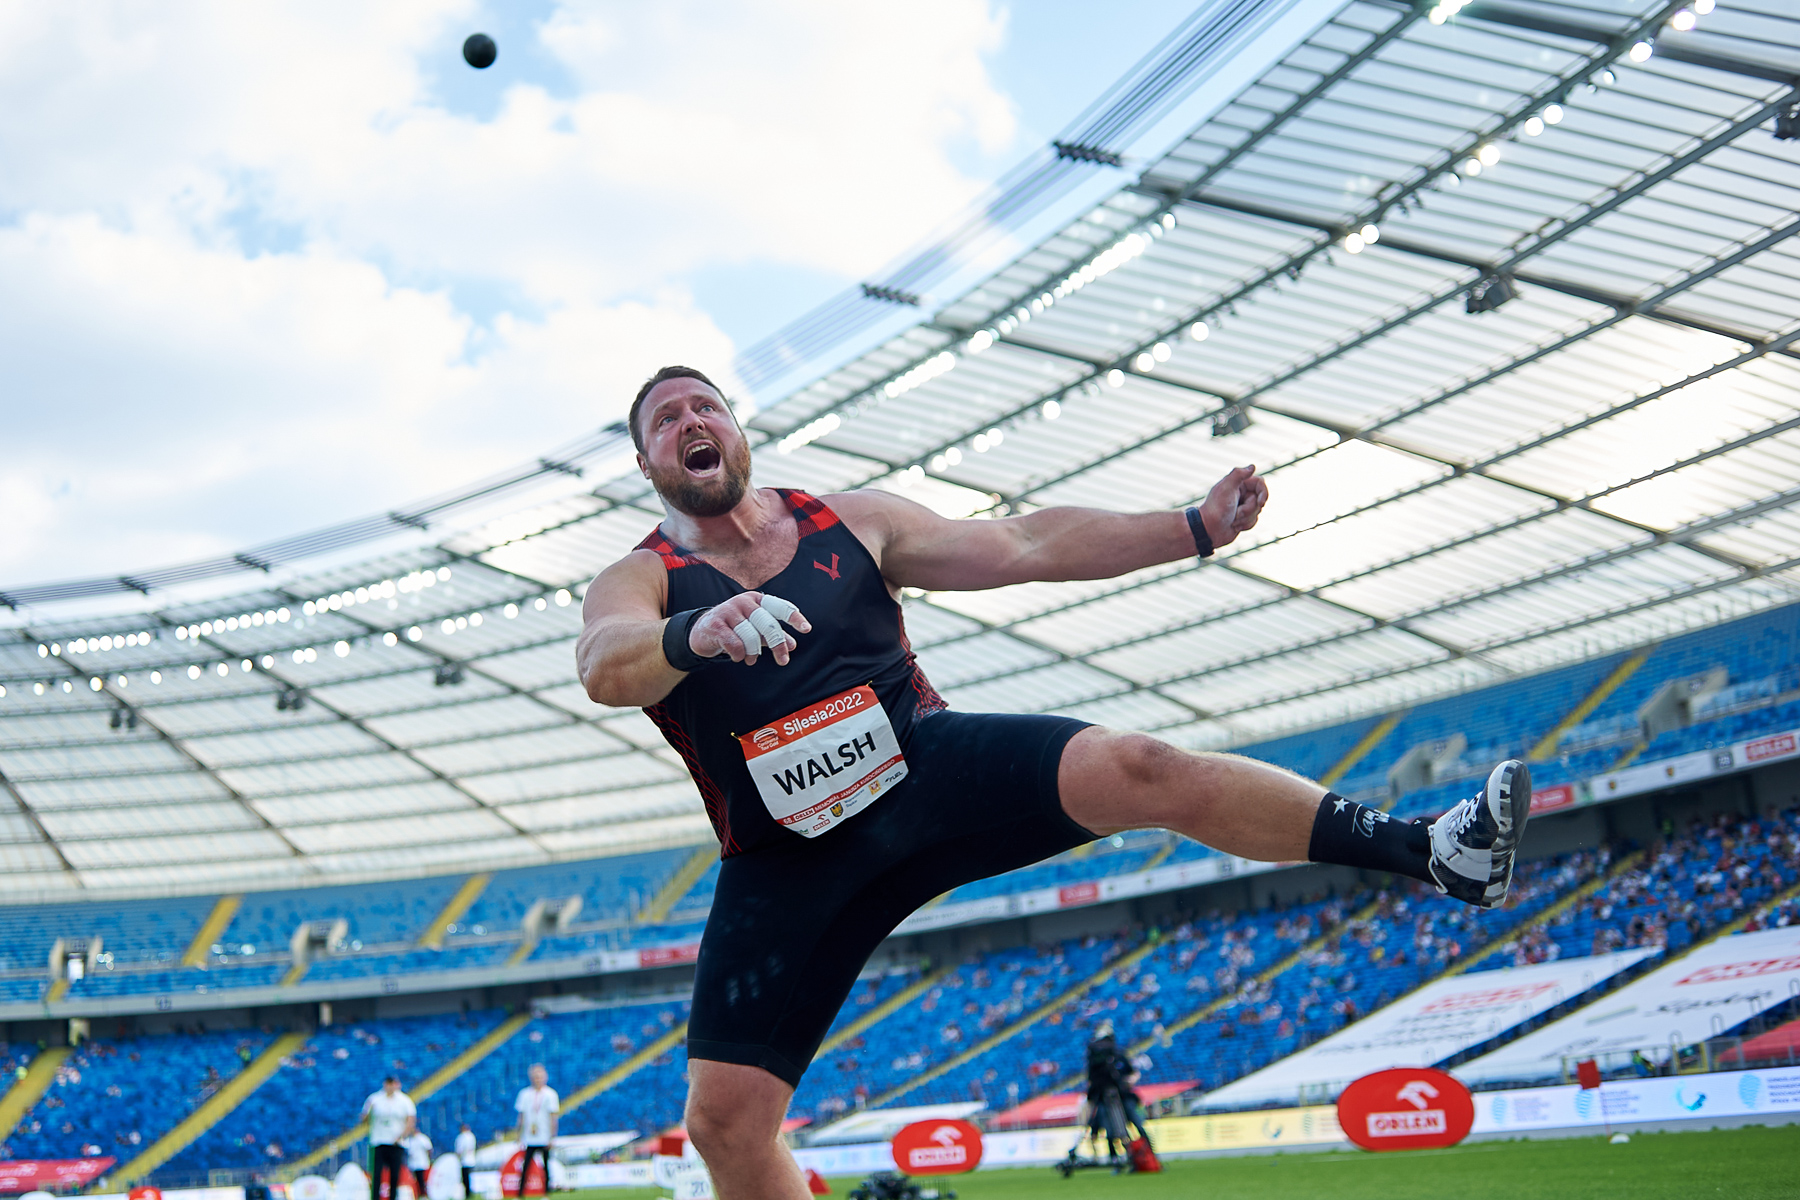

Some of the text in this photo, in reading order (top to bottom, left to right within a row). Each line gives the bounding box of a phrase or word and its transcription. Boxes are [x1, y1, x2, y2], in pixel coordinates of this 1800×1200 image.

[783, 692, 865, 736] Silesia2022
[772, 731, 877, 796] WALSH
[795, 809, 814, 820] ORLEN
[813, 819, 830, 831] ORLEN
[1374, 1115, 1439, 1132] ORLEN
